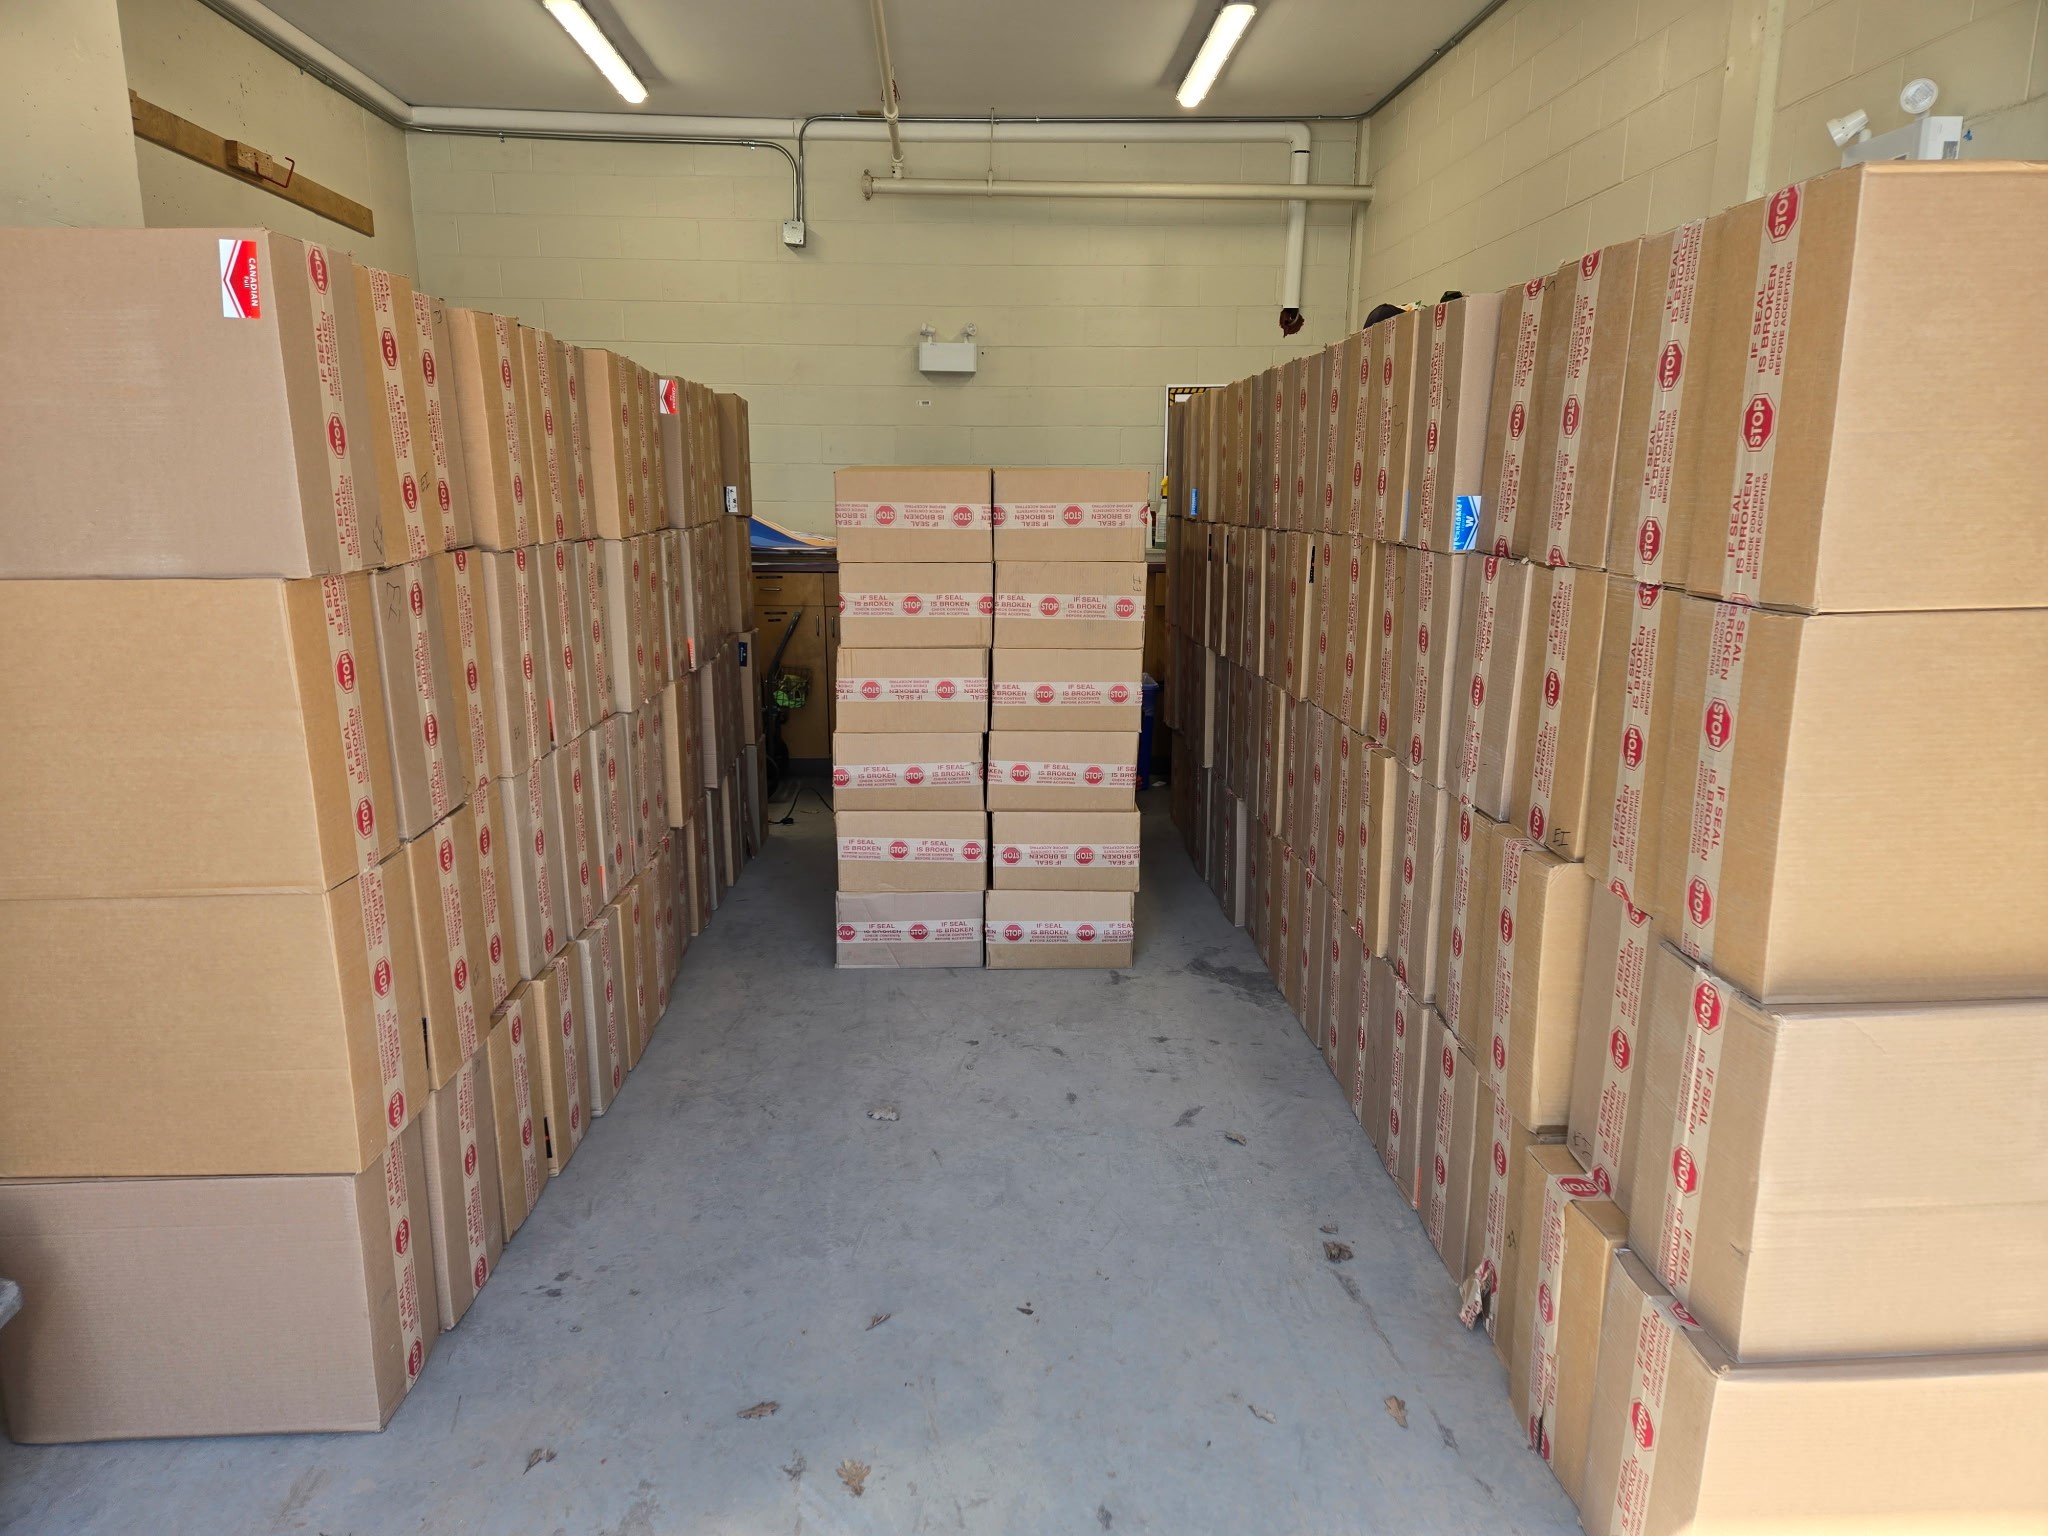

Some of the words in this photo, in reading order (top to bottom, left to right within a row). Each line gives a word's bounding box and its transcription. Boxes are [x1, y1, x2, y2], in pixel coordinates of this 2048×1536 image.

[249, 258, 259, 307] CANADIAN
[1666, 296, 1672, 310] IF
[1669, 244, 1681, 290] SEAL
[1671, 307, 1679, 323] IS
[1675, 226, 1691, 300] BROKEN
[1583, 296, 1589, 310] IS
[1589, 308, 1594, 321] IF
[1753, 284, 1767, 335] SEAL
[1761, 265, 1778, 349] BROKEN
[1768, 332, 1778, 370] CHECK
[1774, 267, 1785, 327] CONTENTS
[1774, 330, 1785, 375] BEFORE
[1781, 261, 1793, 326] ACCEPTING
[316, 326, 324, 364] SEAL
[384, 332, 395, 367] STOP
[1574, 315, 1587, 379] BROKEN
[1583, 327, 1591, 365] SEAL
[1751, 342, 1757, 358] IF
[1758, 339, 1766, 374] IS
[321, 369, 327, 382] IF
[1663, 344, 1675, 389] STOP
[1512, 406, 1522, 436] STOP
[1567, 398, 1575, 435] STOP
[1749, 399, 1766, 449] STOP
[334, 416, 344, 456] STOP
[1652, 410, 1666, 479] BROKEN
[1644, 472, 1650, 485] IF
[1647, 425, 1657, 467] SEAL
[335, 488, 344, 526] SEAL
[405, 475, 415, 510] STOP
[440, 482, 448, 510] STOP
[1649, 485, 1657, 499] IS
[876, 511, 895, 519] STOP
[954, 512, 972, 520] STOP
[1064, 511, 1081, 519] STOP
[1730, 489, 1742, 536] SEAL
[1739, 473, 1754, 550] BROKEN
[1746, 536, 1754, 572] CHECK
[1750, 477, 1761, 533] CONTENTS
[1752, 535, 1761, 579] BEFORE
[1757, 473, 1768, 534] ACCEPTING
[340, 536, 345, 544] IF
[1644, 522, 1655, 559] STOP
[1727, 546, 1735, 558] IF
[1736, 557, 1744, 573] IS
[1041, 602, 1059, 610] STOP
[1116, 604, 1134, 612] STOP
[1629, 637, 1637, 677] SEAL
[1634, 626, 1646, 690] BROKEN
[1720, 606, 1738, 680] BROKEN
[1731, 620, 1745, 666] SEAL
[341, 655, 353, 689] STOP
[1548, 673, 1557, 705] STOP
[1627, 685, 1632, 694] IF
[1633, 695, 1639, 709] IS
[344, 724, 353, 760] SEAL
[349, 708, 360, 767] BROKEN
[1709, 701, 1724, 748] STOP
[1627, 729, 1638, 766] STOP
[349, 766, 355, 775] IF
[357, 771, 363, 783] IS
[906, 772, 923, 780] STOP
[1717, 785, 1725, 802] IF
[360, 801, 370, 834] STOP
[1533, 808, 1542, 838] STOP
[1710, 806, 1723, 850] SEAL
[890, 846, 908, 854] STOP
[1692, 880, 1706, 923] STOP
[1005, 929, 1022, 937] STOP
[1077, 929, 1095, 937] STOP
[378, 962, 388, 993] STOP
[457, 961, 465, 988] STOP
[1699, 986, 1715, 1028] STOP
[1615, 1030, 1625, 1067] STOP
[1705, 1067, 1714, 1084] IF
[392, 1094, 400, 1124] STOP
[1698, 1086, 1712, 1125] SEAL
[1677, 1150, 1691, 1192] STOP
